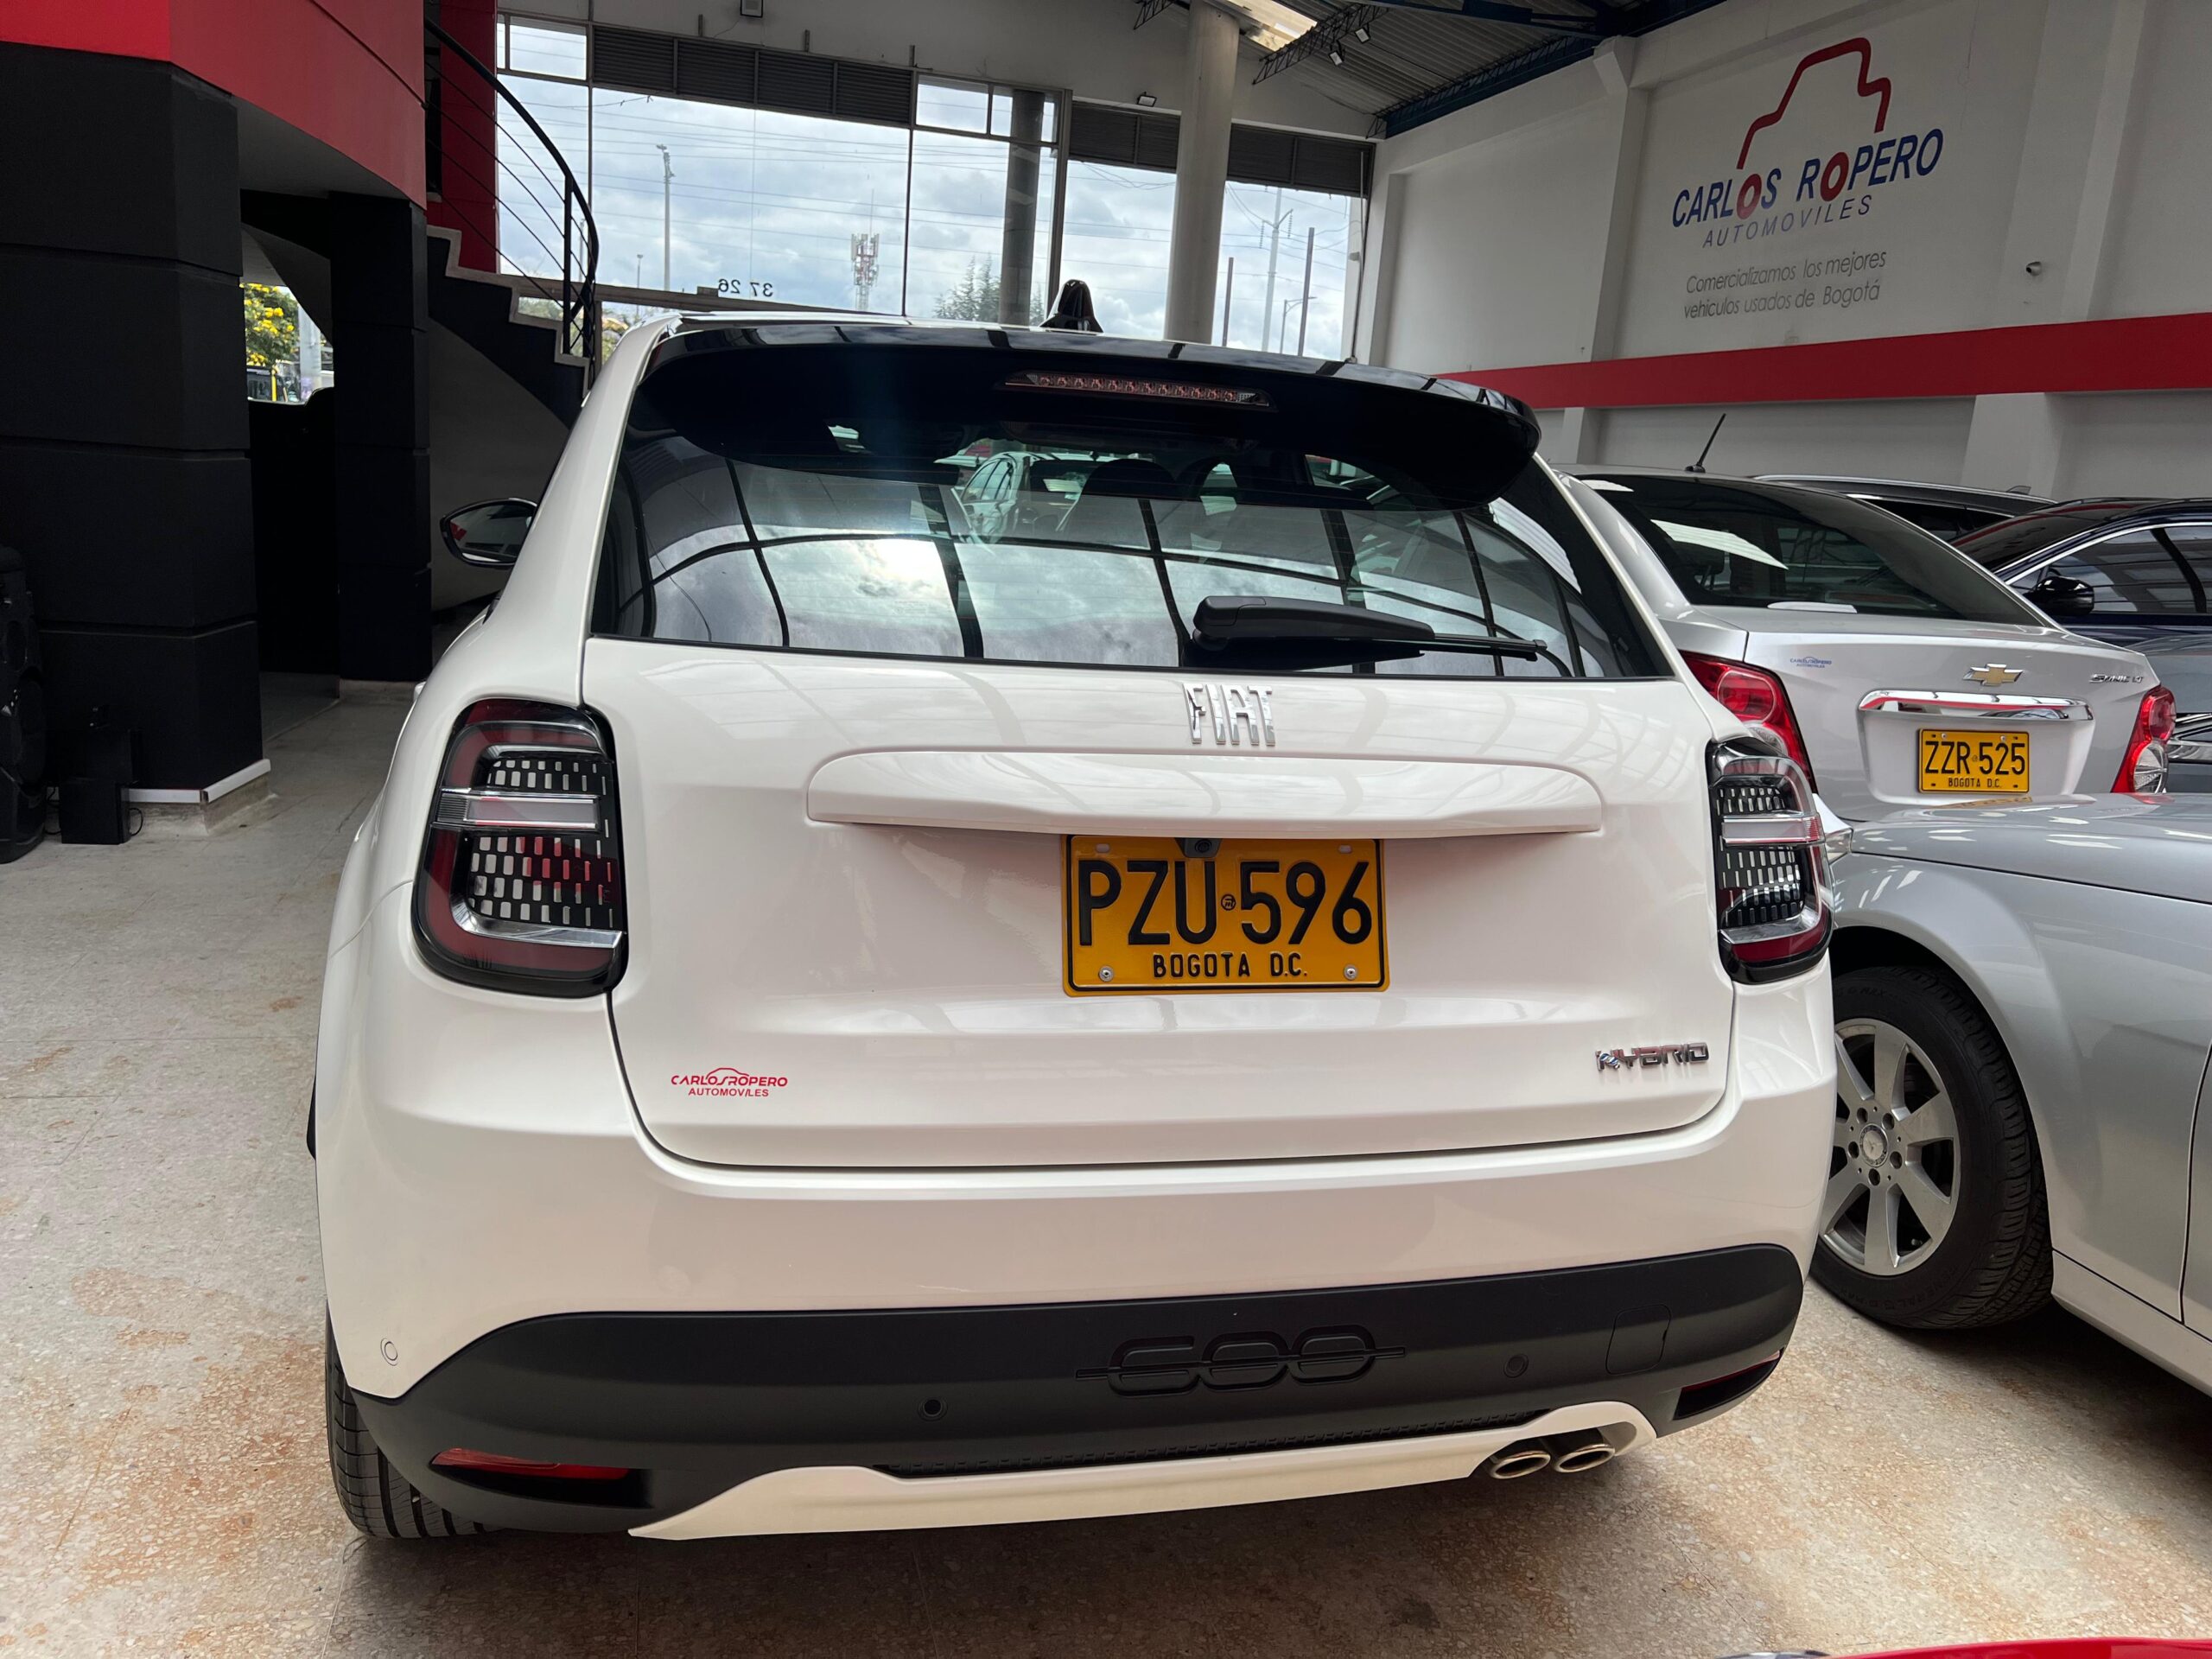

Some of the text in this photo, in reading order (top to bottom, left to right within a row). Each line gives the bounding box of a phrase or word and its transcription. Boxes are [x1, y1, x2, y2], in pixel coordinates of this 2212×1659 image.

[1672, 128, 1944, 228] CARLOS ROPERO
[1702, 194, 1872, 248] AUTOMOVILES
[1686, 251, 1887, 293] Comercializamos los mejores
[1744, 291, 1792, 313] usados
[1795, 289, 1815, 308] de
[1822, 279, 1881, 308] Bogotá
[1182, 683, 1276, 747] FIAT
[1925, 741, 2025, 775] ZZR 525
[1948, 778, 1981, 787] BOGOTA
[1078, 859, 1372, 946] PZU 596
[1153, 951, 1308, 978] BOGOTA D.C.
[1595, 1042, 1710, 1071] HYBRID
[688, 1088, 769, 1097] AUTOMOVILES
[1107, 1324, 1376, 1397] 600
